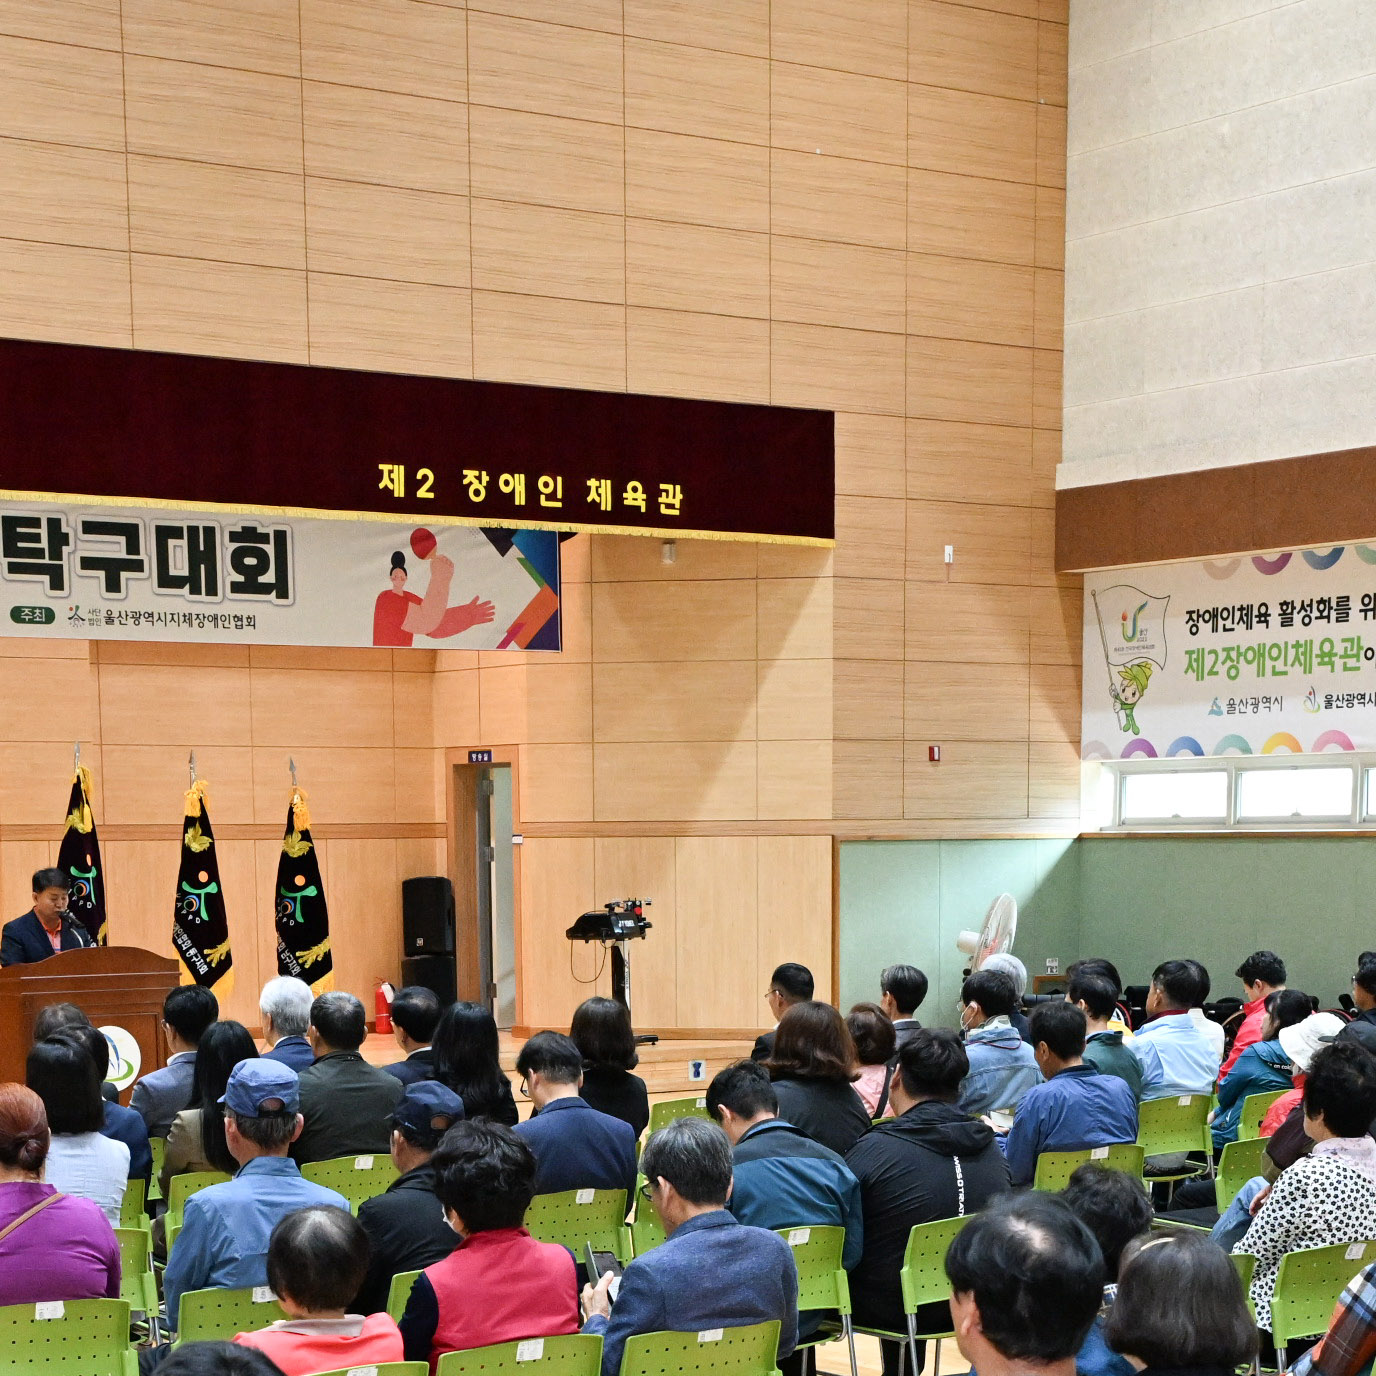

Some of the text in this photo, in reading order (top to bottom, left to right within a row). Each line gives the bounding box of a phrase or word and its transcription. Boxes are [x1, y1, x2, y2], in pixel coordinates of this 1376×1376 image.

[378, 463, 683, 516] 제2 장애인 체육관
[0, 512, 294, 603] 탁구대회
[20, 607, 46, 623] 주최
[103, 609, 256, 630] 울산광역시지체장애인협회
[1185, 602, 1272, 636] 장애인체육
[1278, 595, 1352, 628] 활성화를
[1226, 697, 1283, 715] 울산광역시
[185, 947, 209, 976] 동구지회
